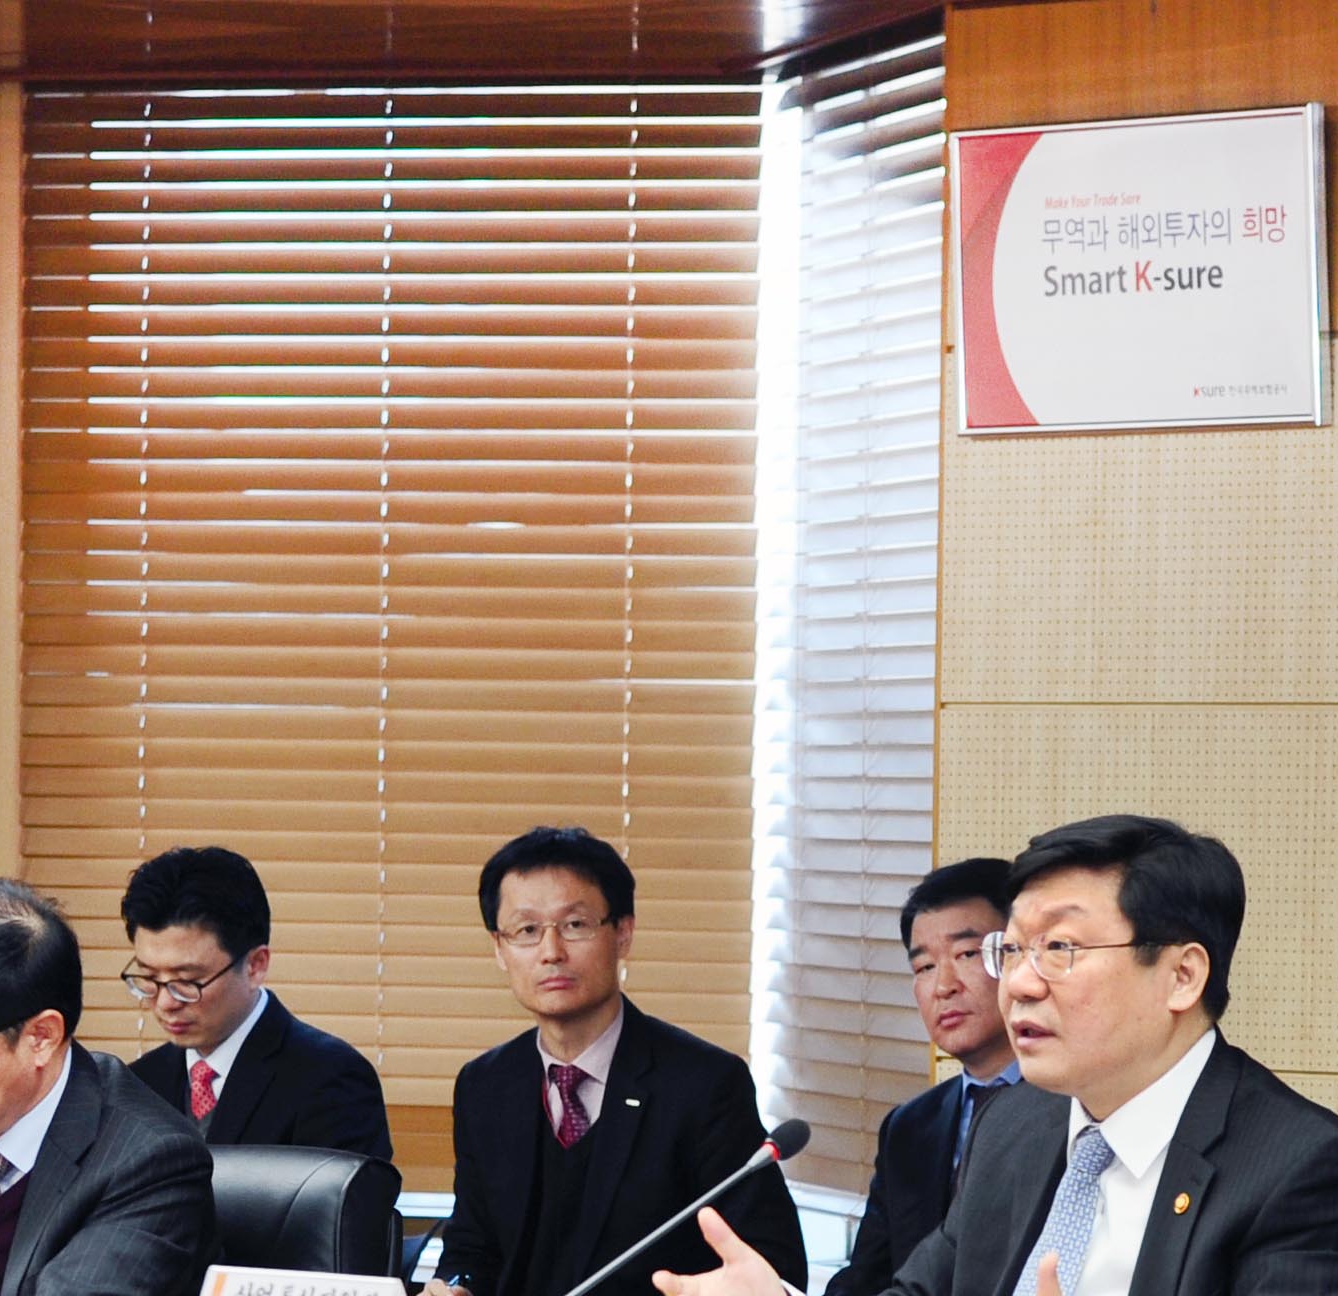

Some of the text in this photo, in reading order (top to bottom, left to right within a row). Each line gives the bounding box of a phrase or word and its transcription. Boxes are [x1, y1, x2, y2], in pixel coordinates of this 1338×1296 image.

[1042, 204, 1288, 254] 무역과 해외투자의 희망
[1043, 260, 1224, 297] Smart K-sure
